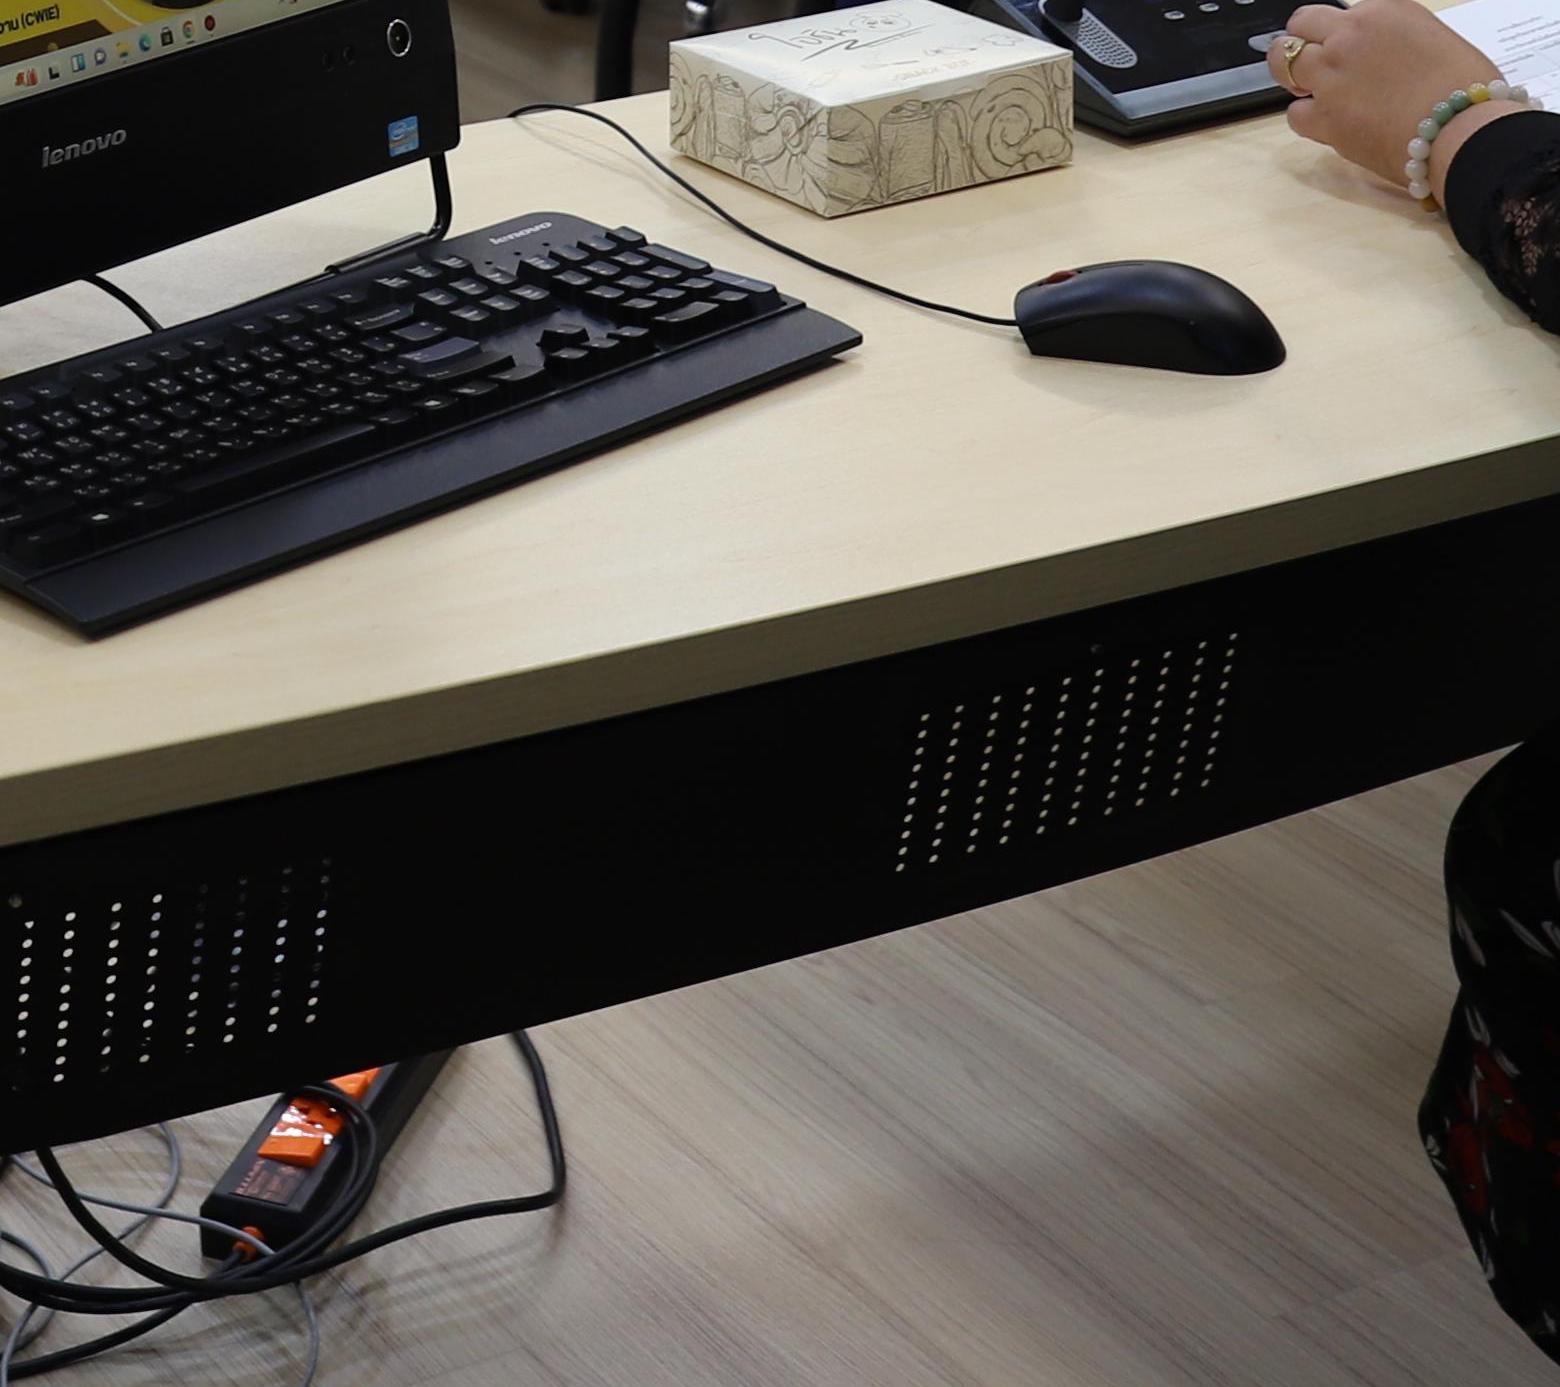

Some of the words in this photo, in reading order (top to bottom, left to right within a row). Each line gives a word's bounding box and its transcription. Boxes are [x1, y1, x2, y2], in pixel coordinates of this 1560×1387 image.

[20, 5, 61, 32] (CWIE)
[41, 129, 127, 168] lenovo
[489, 221, 552, 245] lenovo
